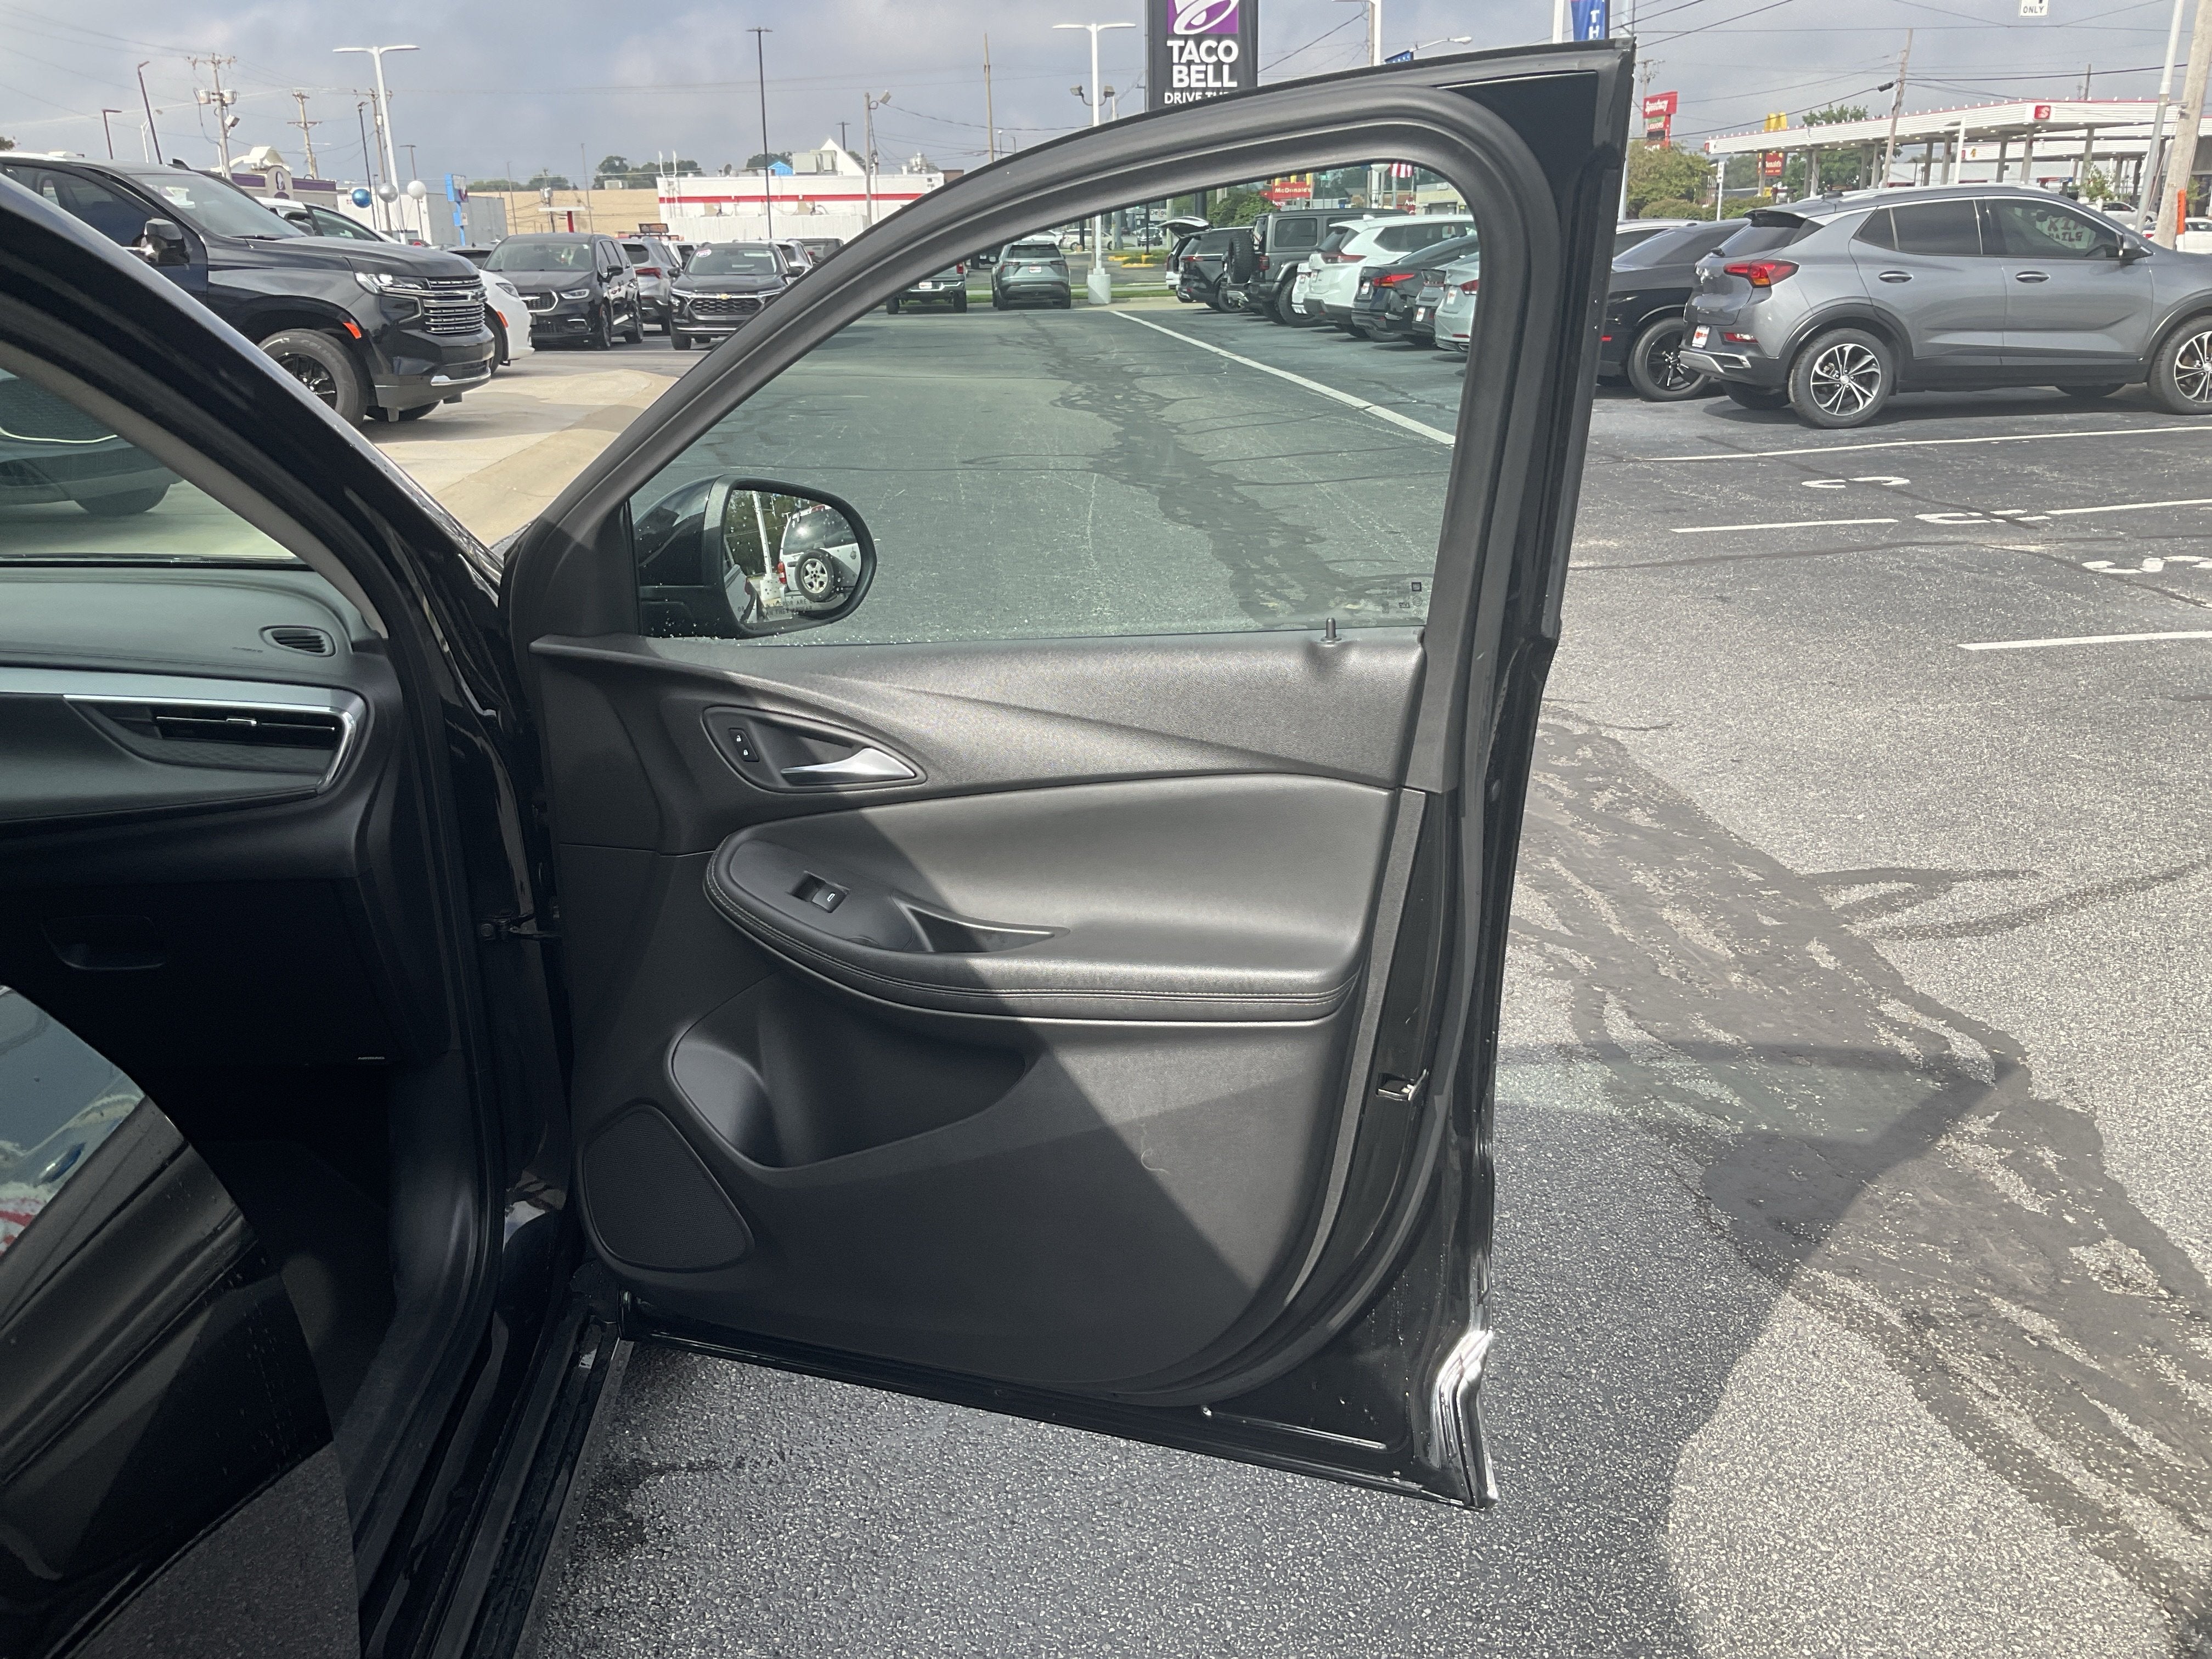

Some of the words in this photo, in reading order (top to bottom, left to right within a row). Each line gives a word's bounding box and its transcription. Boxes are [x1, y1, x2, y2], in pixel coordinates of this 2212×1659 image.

[2023, 5, 2044, 14] ONLY
[1166, 40, 1239, 63] TACO
[1172, 64, 1238, 88] BELL
